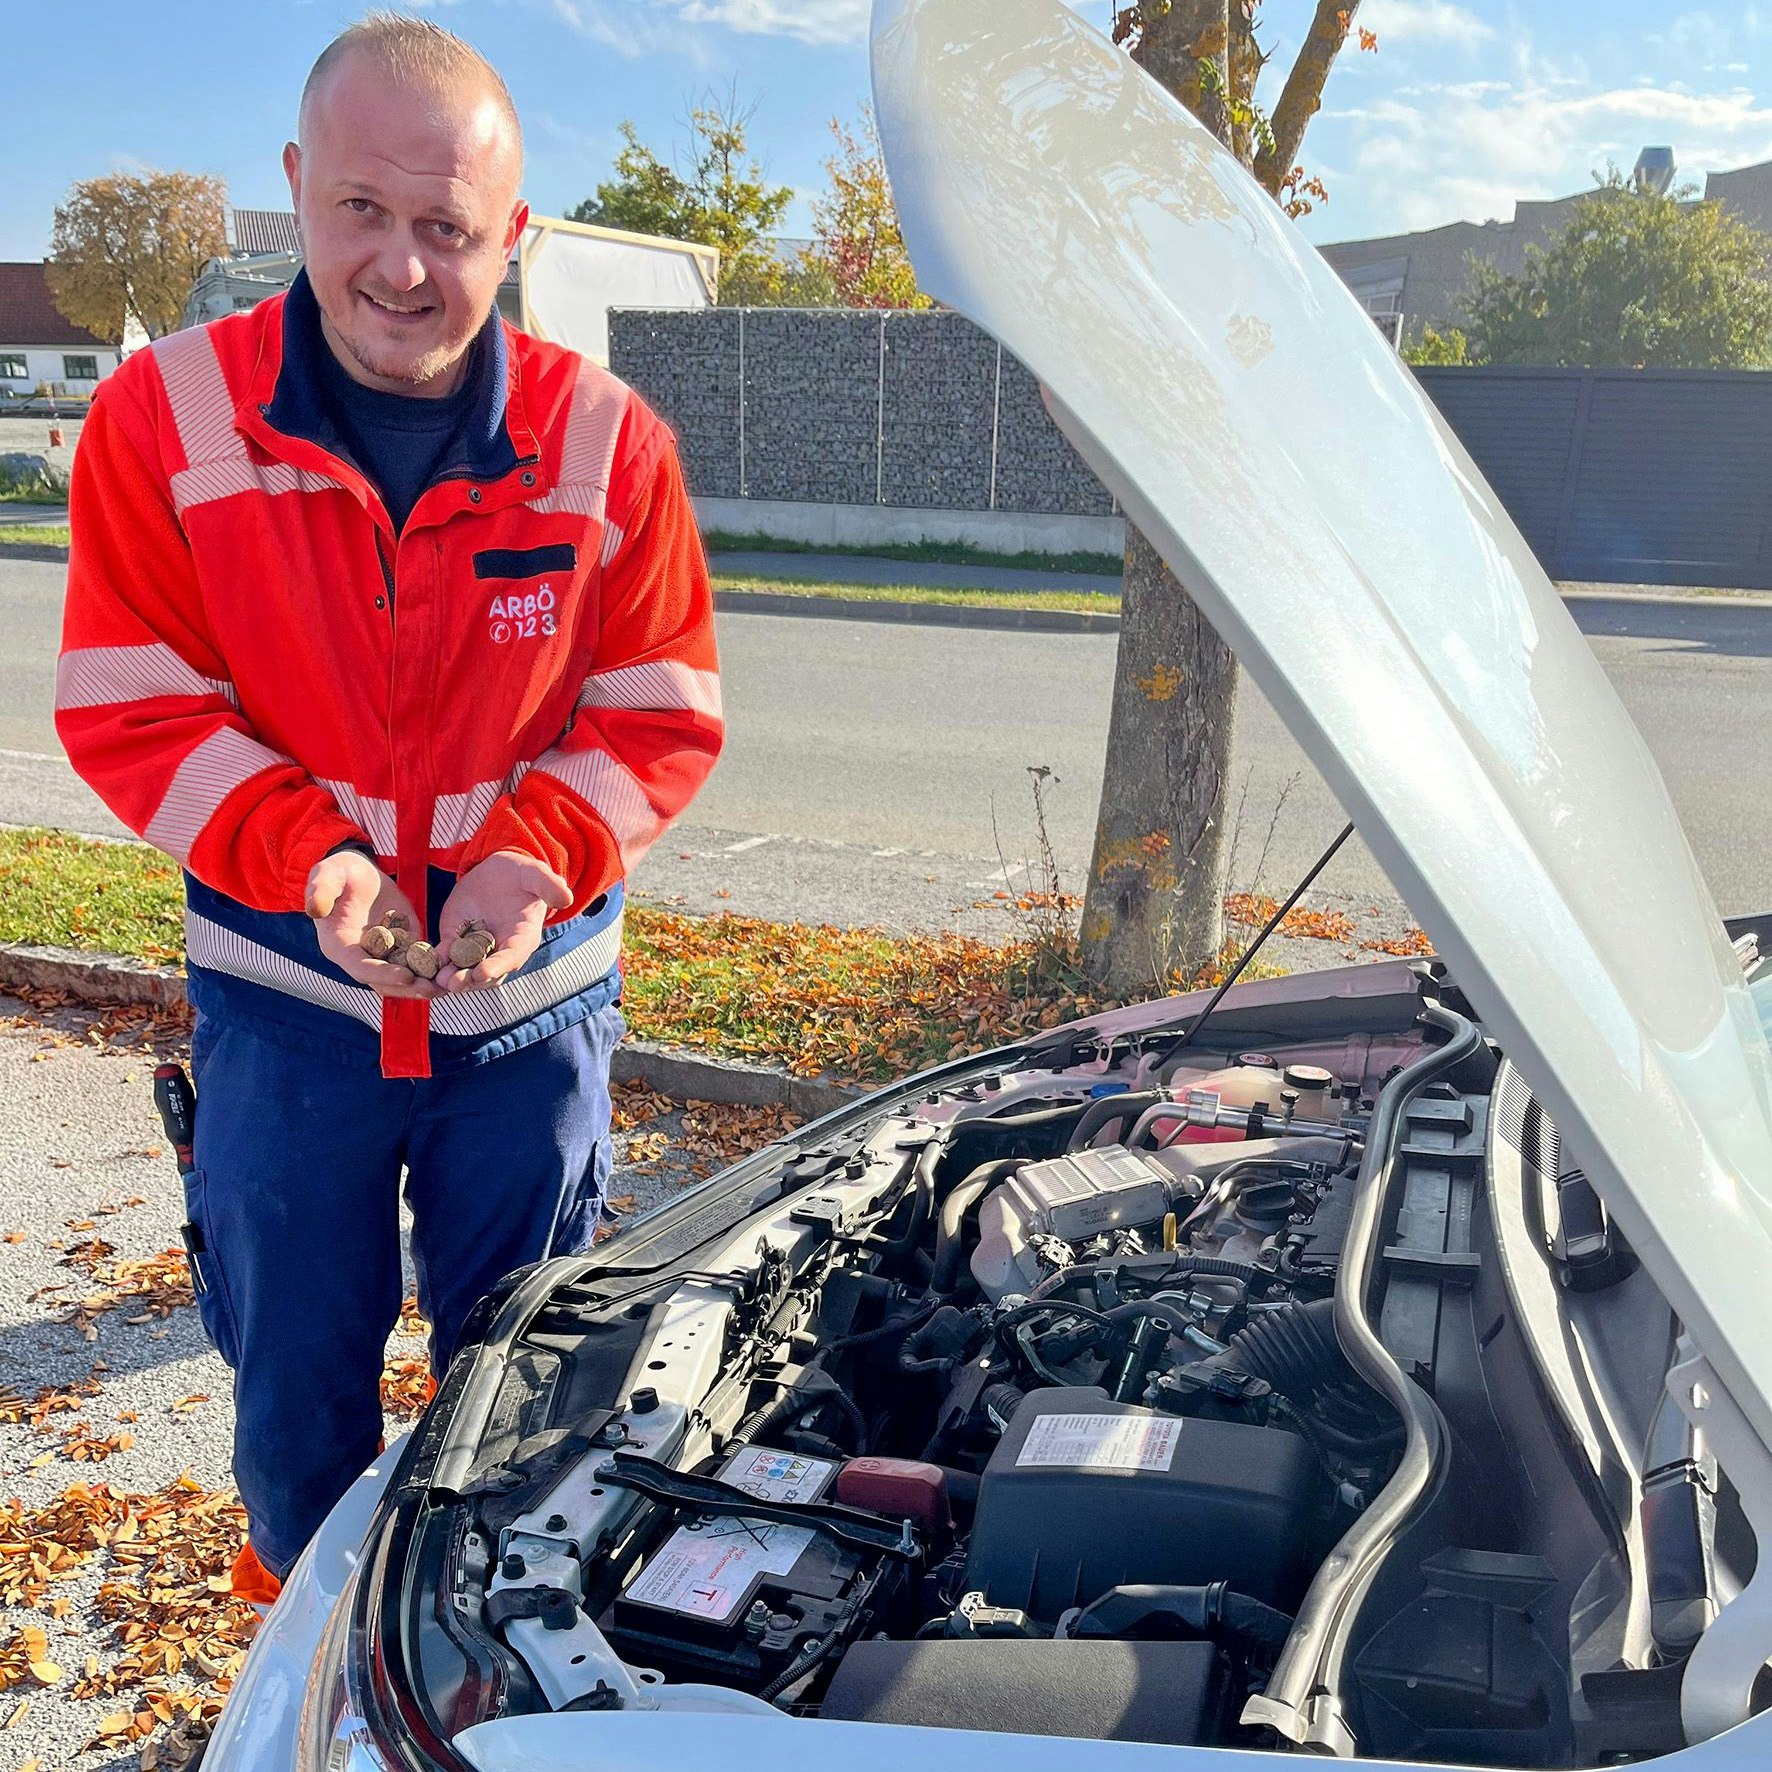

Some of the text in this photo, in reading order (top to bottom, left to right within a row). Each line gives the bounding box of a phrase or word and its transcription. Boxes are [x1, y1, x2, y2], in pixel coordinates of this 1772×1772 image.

[489, 583, 555, 619] ARBÖ
[708, 1545, 738, 1579] Performance
[734, 1547, 748, 1561] High
